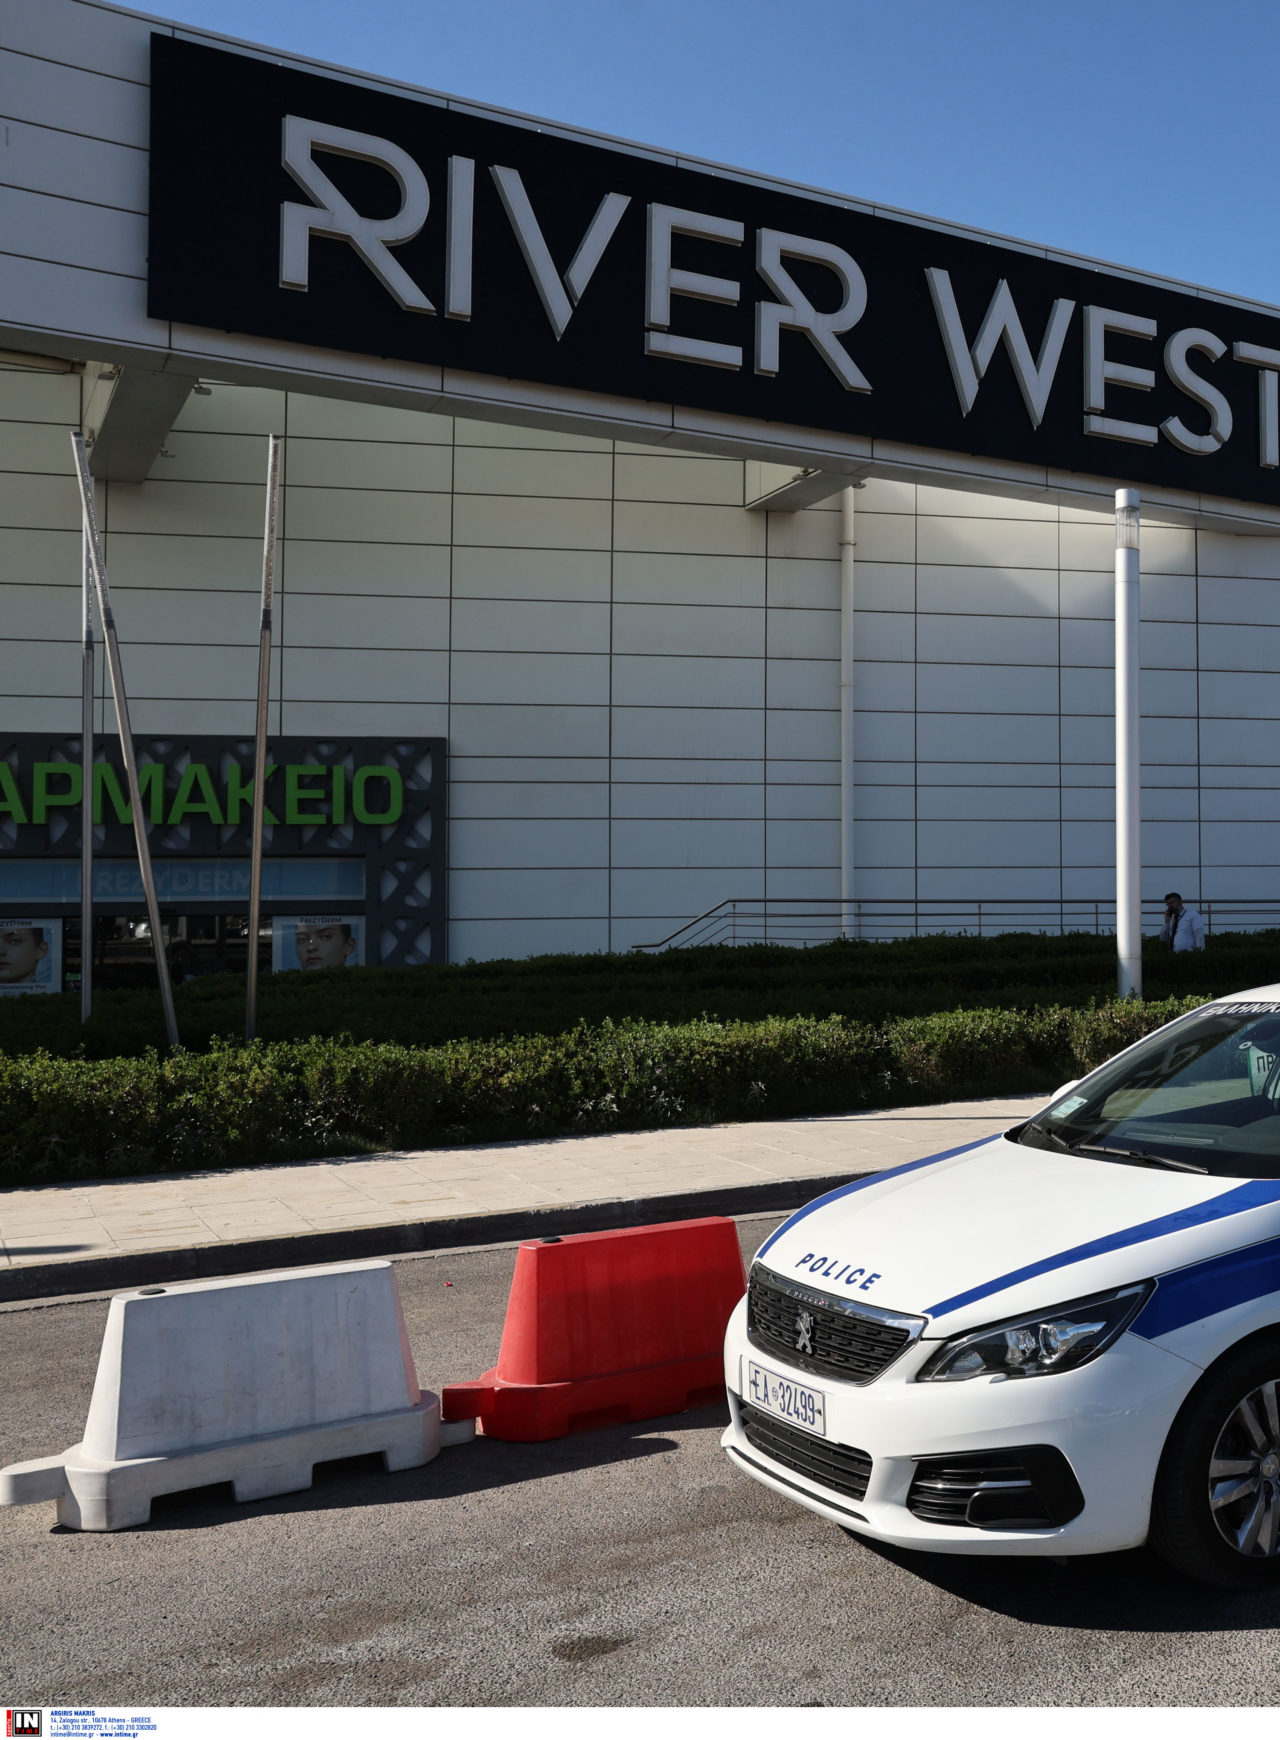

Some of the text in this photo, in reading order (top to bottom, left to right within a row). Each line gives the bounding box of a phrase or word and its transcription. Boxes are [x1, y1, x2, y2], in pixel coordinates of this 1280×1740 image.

[278, 112, 873, 395] RIVER
[77, 866, 255, 893] REZYDERM
[795, 1252, 882, 1291] POLICE
[778, 1381, 816, 1426] 32499
